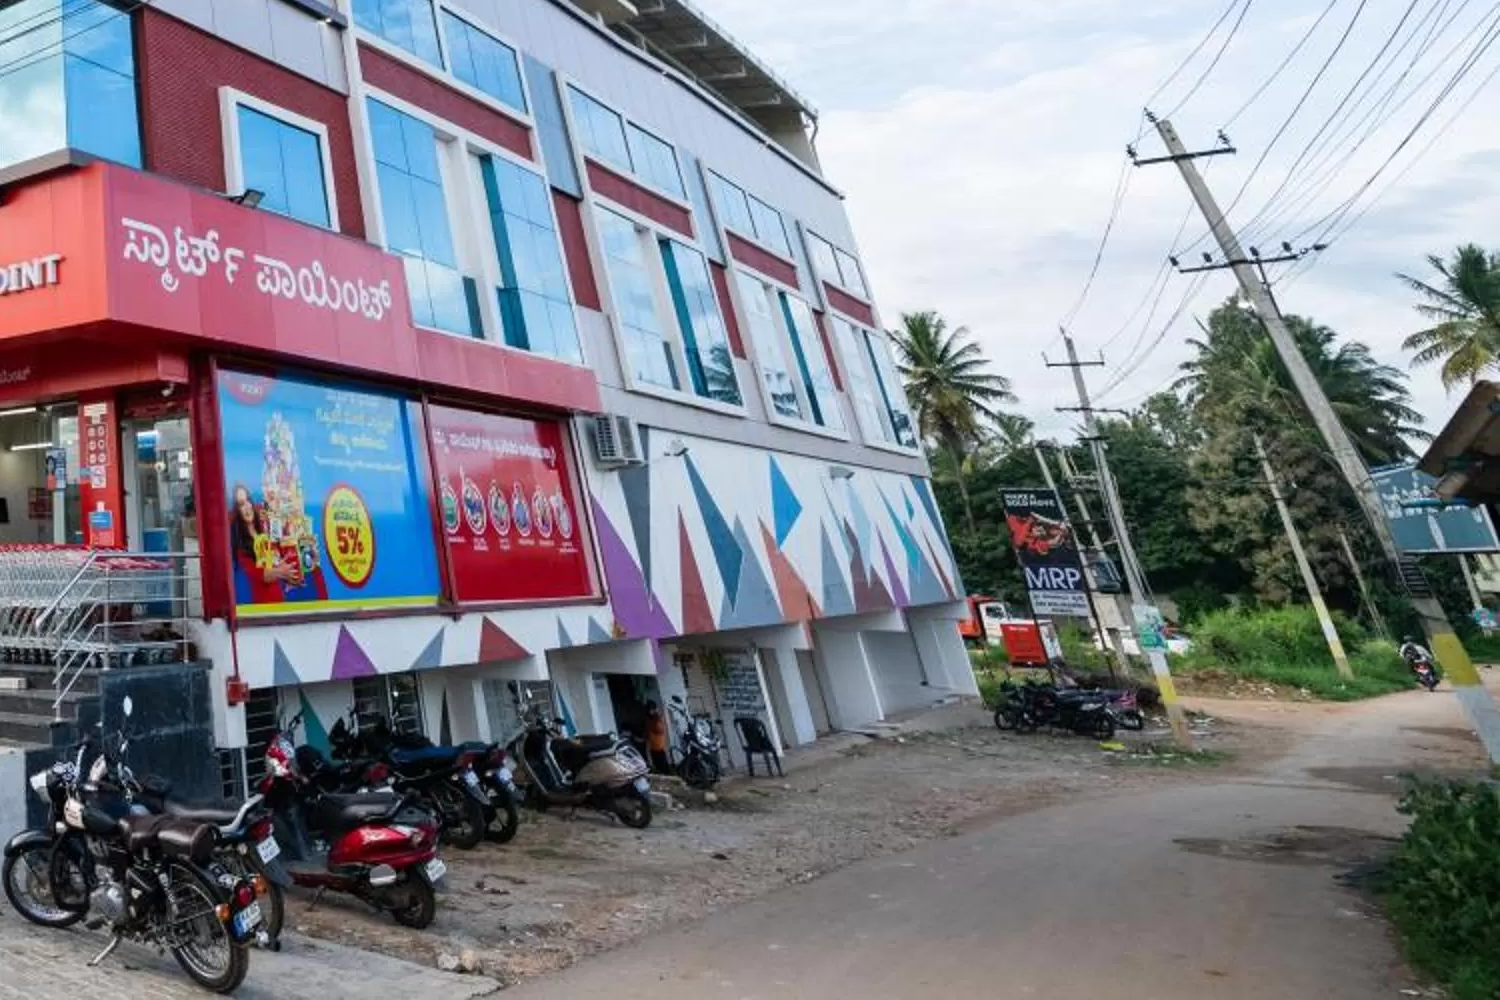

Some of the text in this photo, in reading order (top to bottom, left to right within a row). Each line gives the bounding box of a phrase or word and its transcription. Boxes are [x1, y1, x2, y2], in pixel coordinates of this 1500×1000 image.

[253, 253, 392, 321] ಪಾಯಿಂಟ್
[336, 526, 365, 556] 5%
[1025, 567, 1081, 589] MRP
